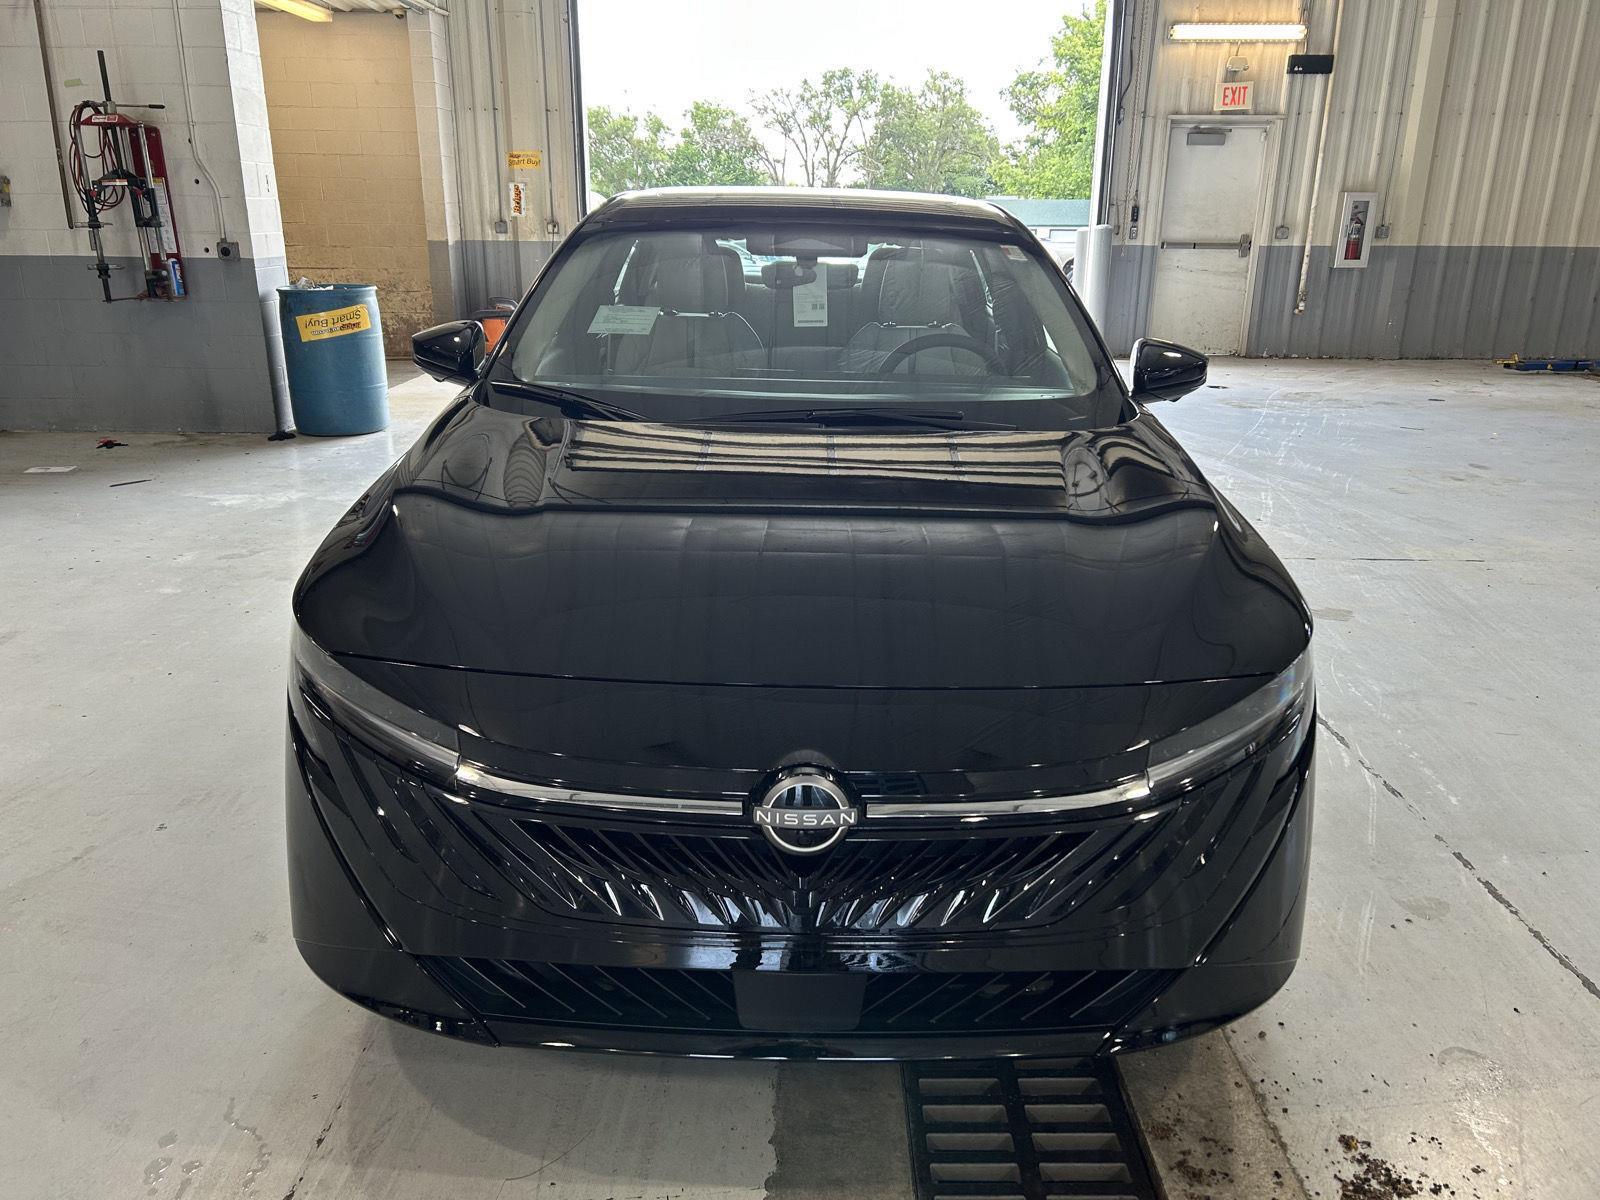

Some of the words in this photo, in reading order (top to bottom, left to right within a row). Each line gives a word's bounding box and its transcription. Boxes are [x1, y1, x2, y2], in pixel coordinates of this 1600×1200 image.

[1222, 86, 1248, 105] EXIT
[304, 317, 329, 328] Buy!
[332, 310, 361, 326] Smart
[756, 810, 854, 826] NISSAN
